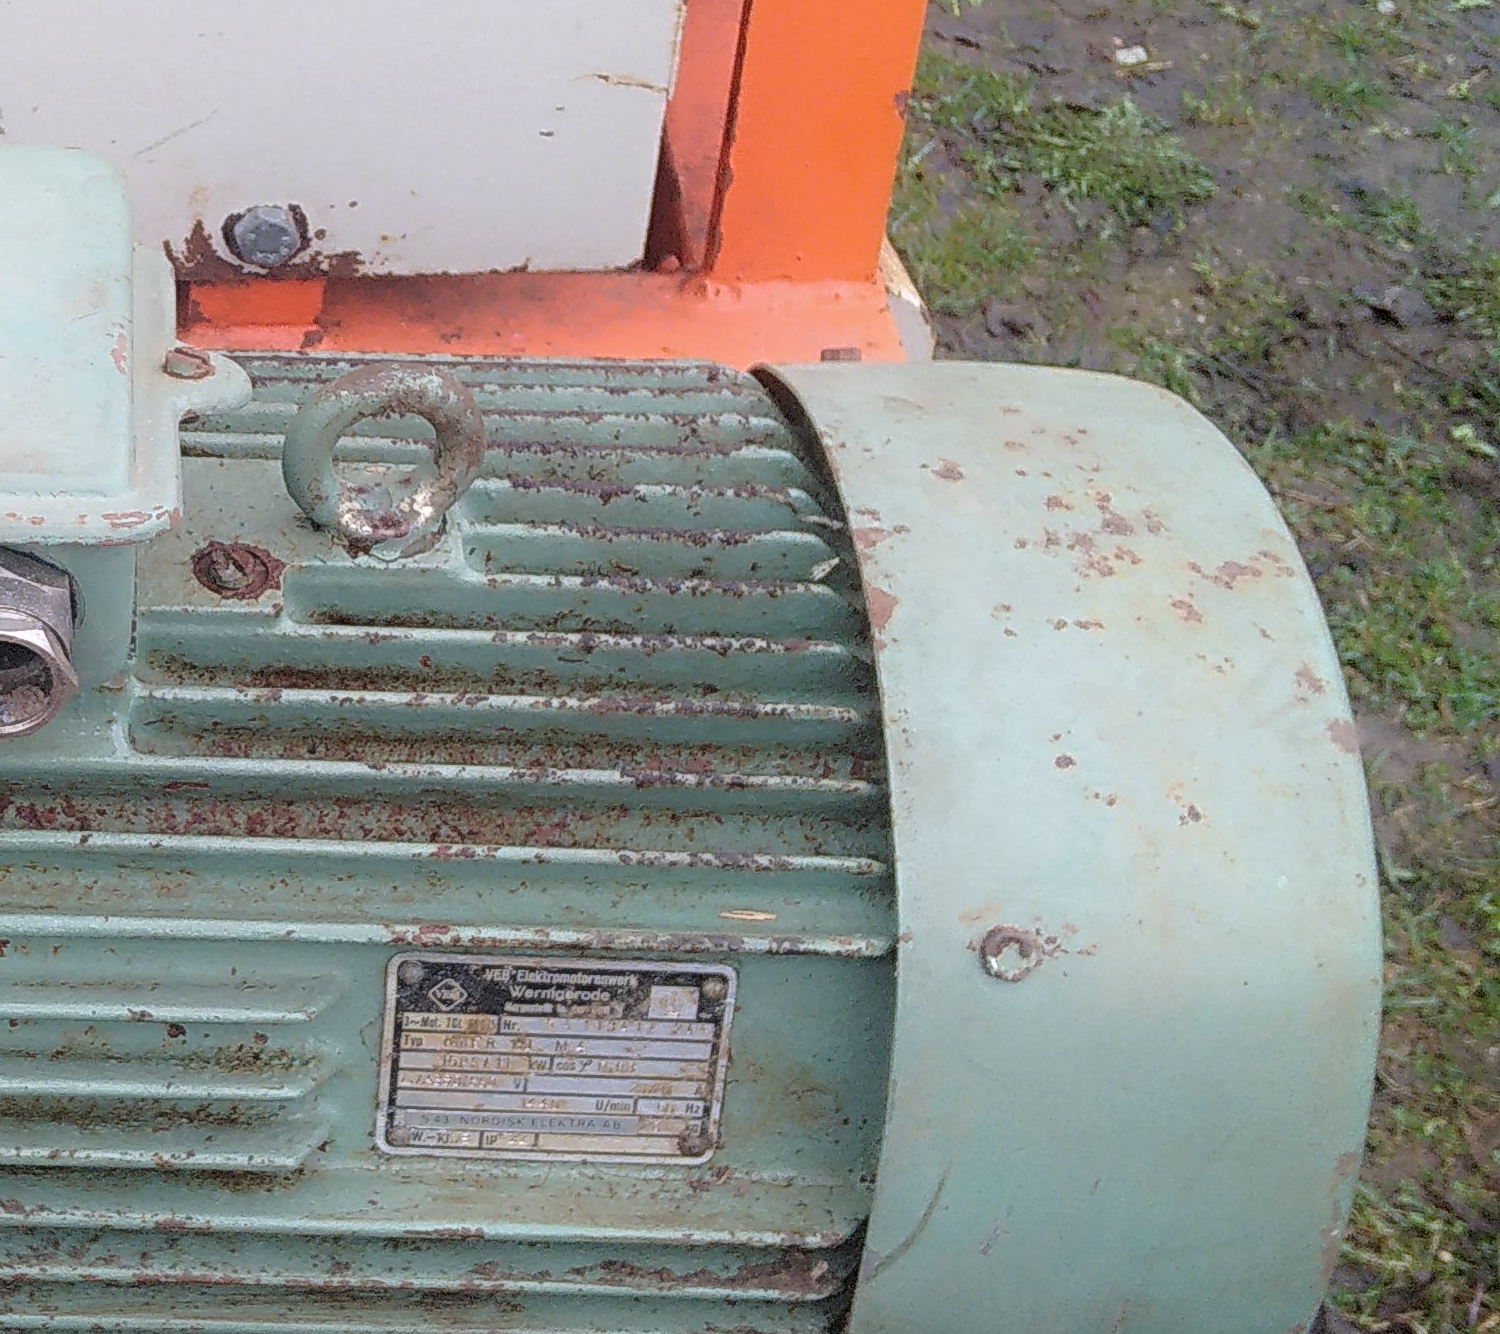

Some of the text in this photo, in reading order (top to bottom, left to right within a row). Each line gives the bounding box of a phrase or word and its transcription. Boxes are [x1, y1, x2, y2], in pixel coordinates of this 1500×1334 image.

[404, 1034, 423, 1047] Typ
[595, 1098, 631, 1112] U/min
[685, 1102, 701, 1115] Hz
[459, 1116, 525, 1128] NORDISK
[531, 1118, 595, 1129] ELEKTRA
